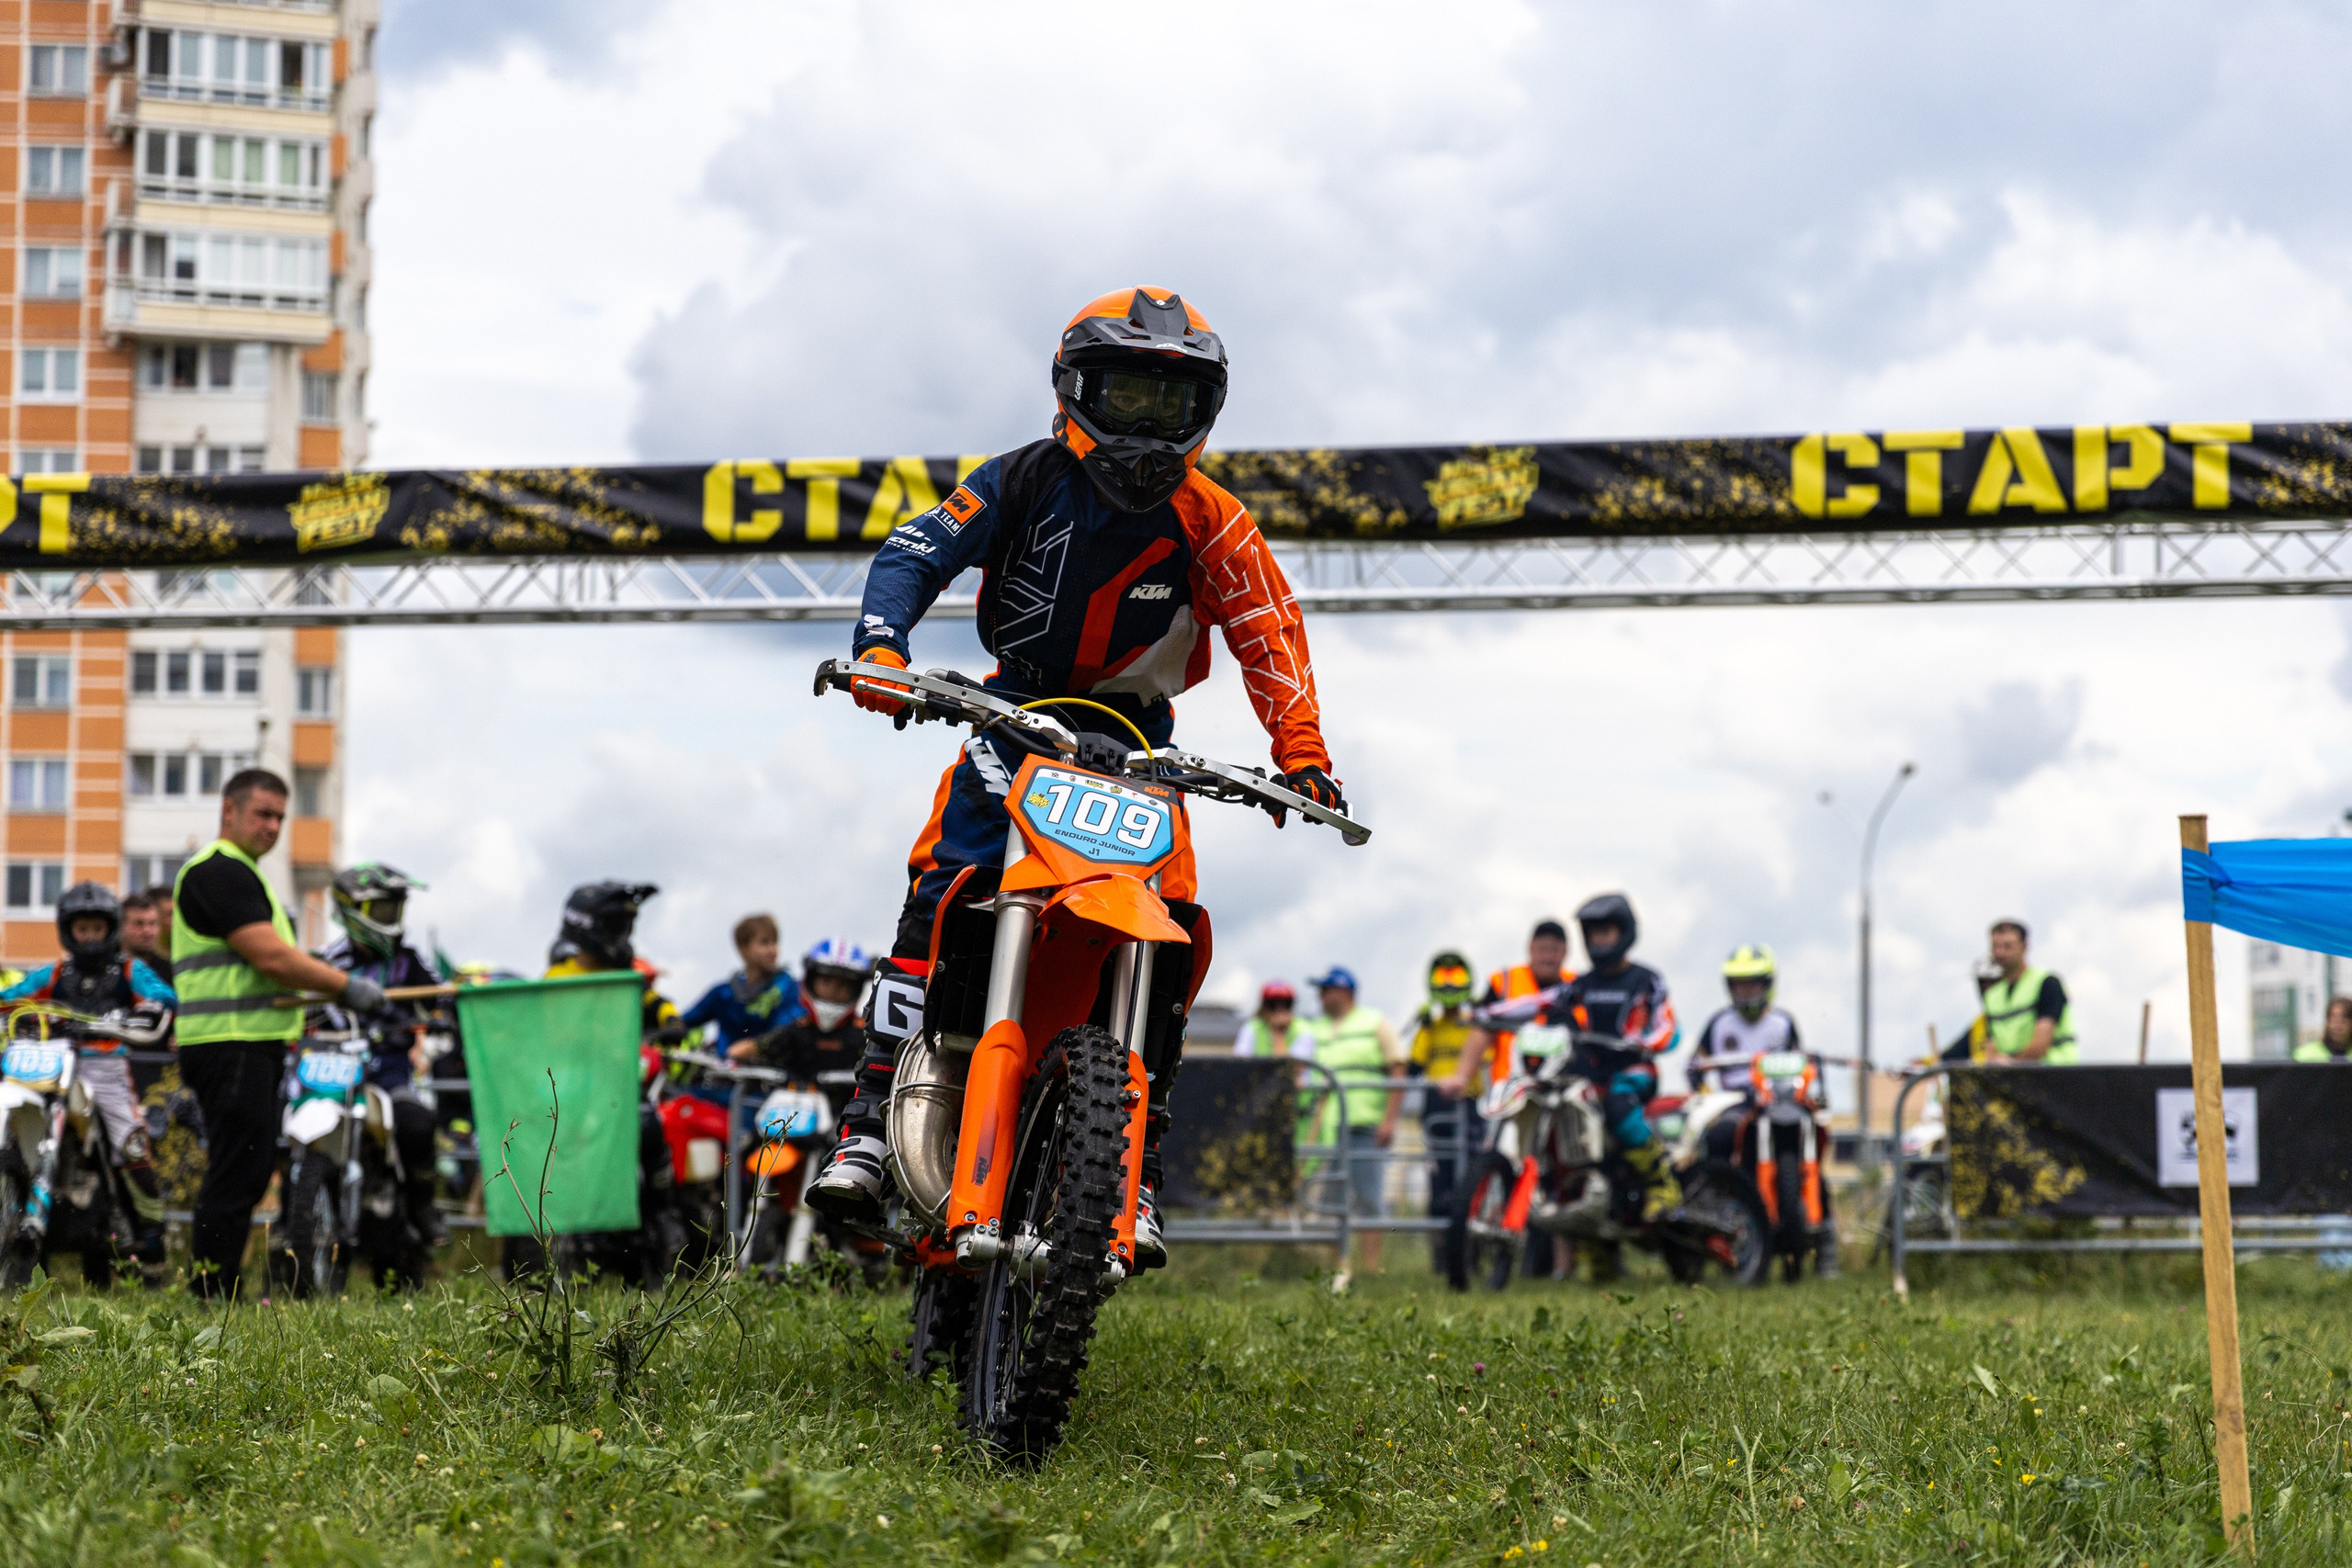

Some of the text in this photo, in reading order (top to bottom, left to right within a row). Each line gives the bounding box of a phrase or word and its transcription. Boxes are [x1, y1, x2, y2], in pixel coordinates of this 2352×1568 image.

[1791, 421, 2255, 520] СТАРТ
[702, 455, 1000, 543] СТА
[940, 511, 961, 533] TEAM
[886, 536, 937, 554] ankl
[1128, 583, 1173, 600] KTM
[1143, 785, 1170, 798] KTM
[1046, 784, 1162, 851] 109
[1054, 829, 1136, 857] ENDURO JUNIOR
[1088, 847, 1101, 857] J1
[975, 1156, 989, 1185] KTM
